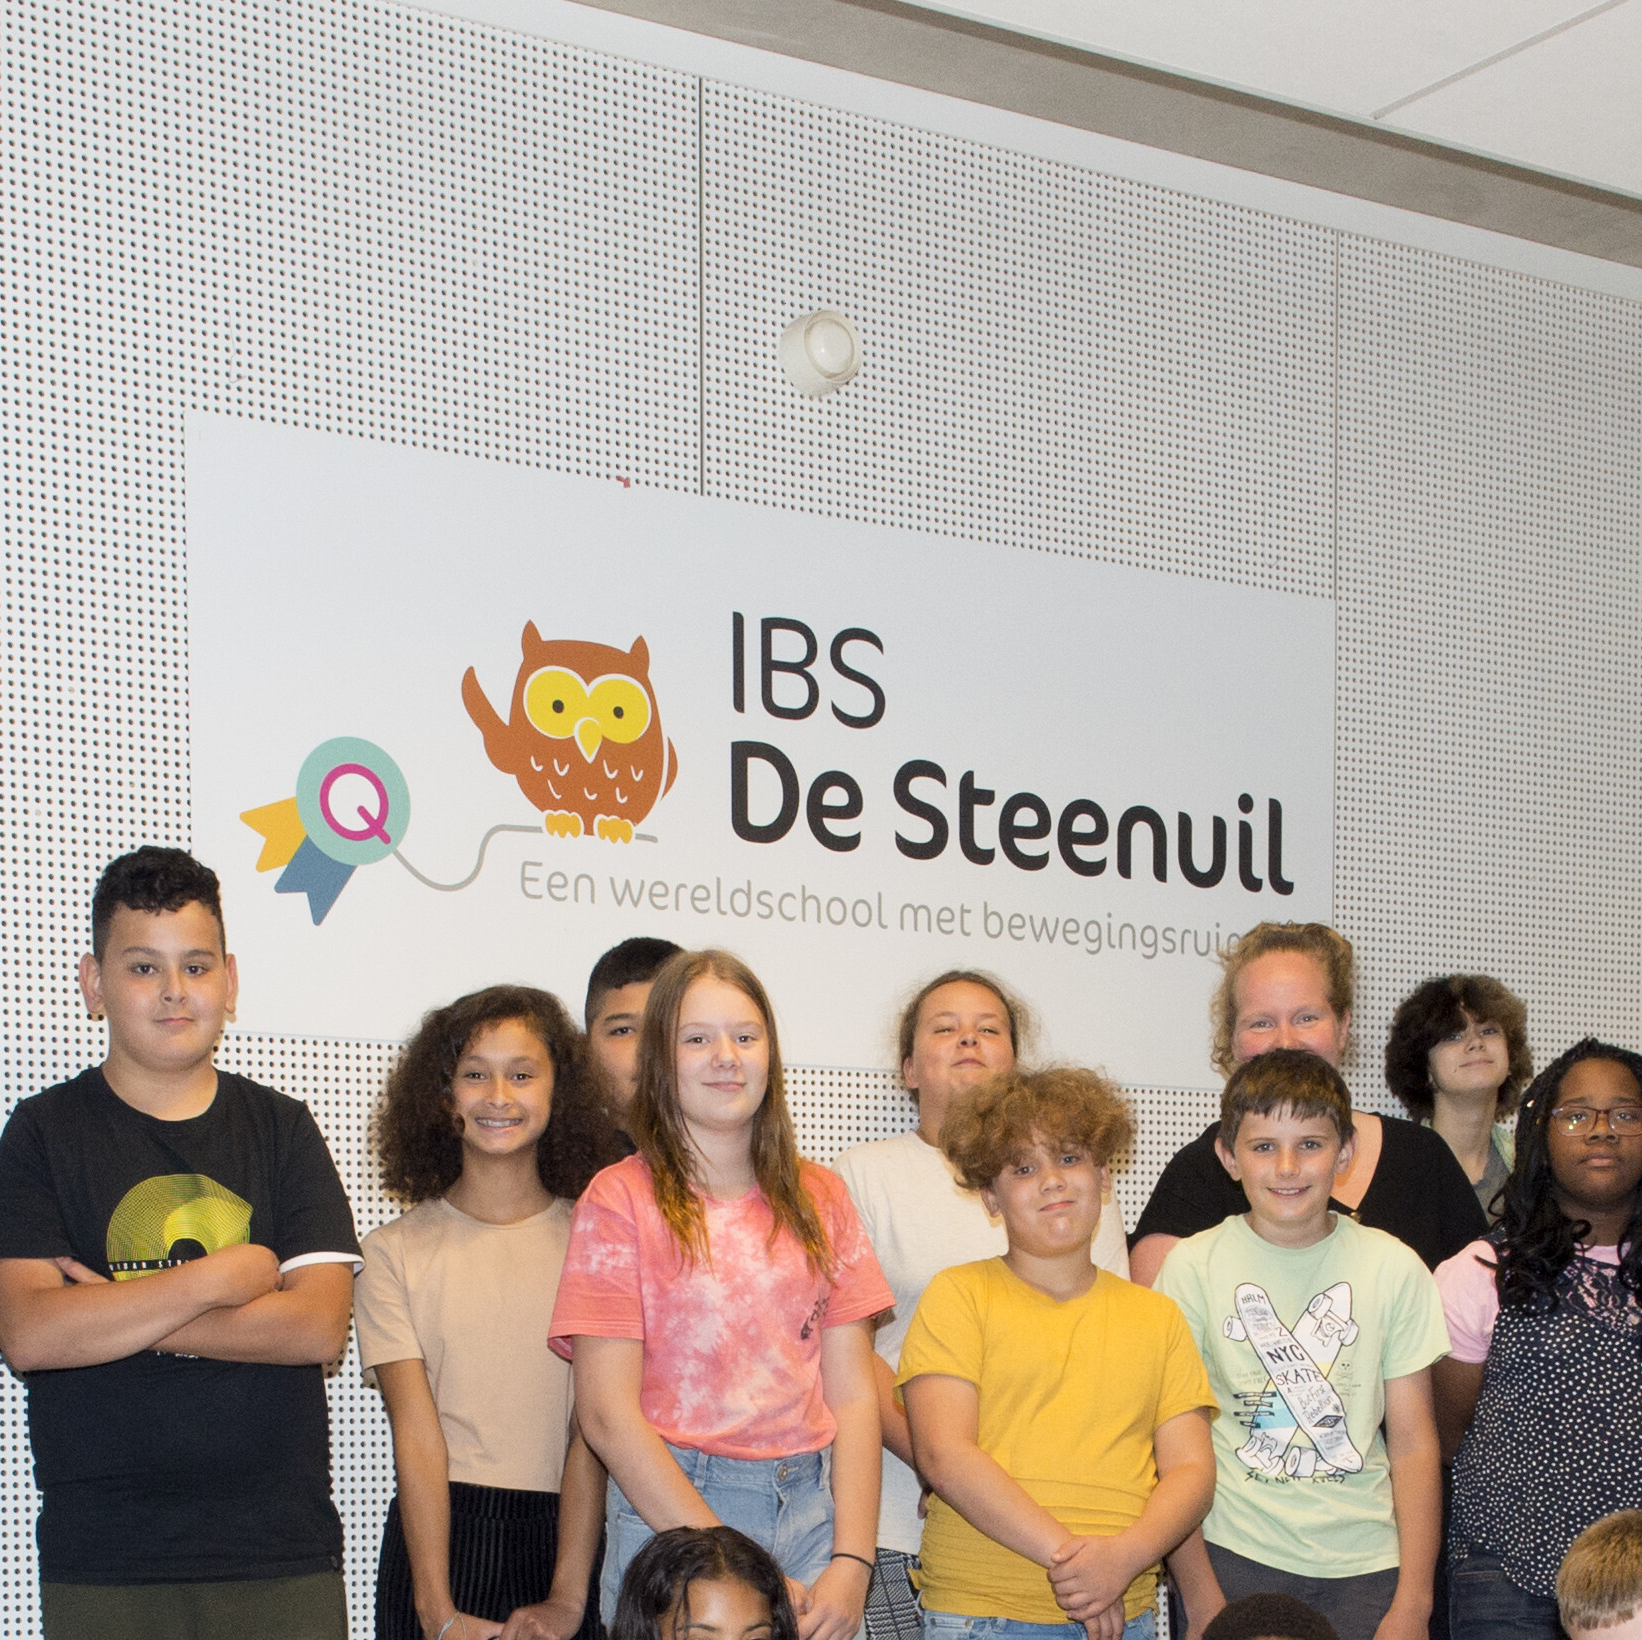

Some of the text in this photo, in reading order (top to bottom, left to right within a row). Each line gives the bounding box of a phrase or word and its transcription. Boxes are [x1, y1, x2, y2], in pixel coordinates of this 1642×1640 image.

[732, 611, 886, 729] IBS
[731, 740, 1295, 896] De Steenuil
[521, 861, 595, 903] Een
[610, 877, 888, 930] wereldschool
[900, 903, 972, 937] met
[1266, 1344, 1305, 1364] NYC
[1276, 1368, 1324, 1386] SKATE
